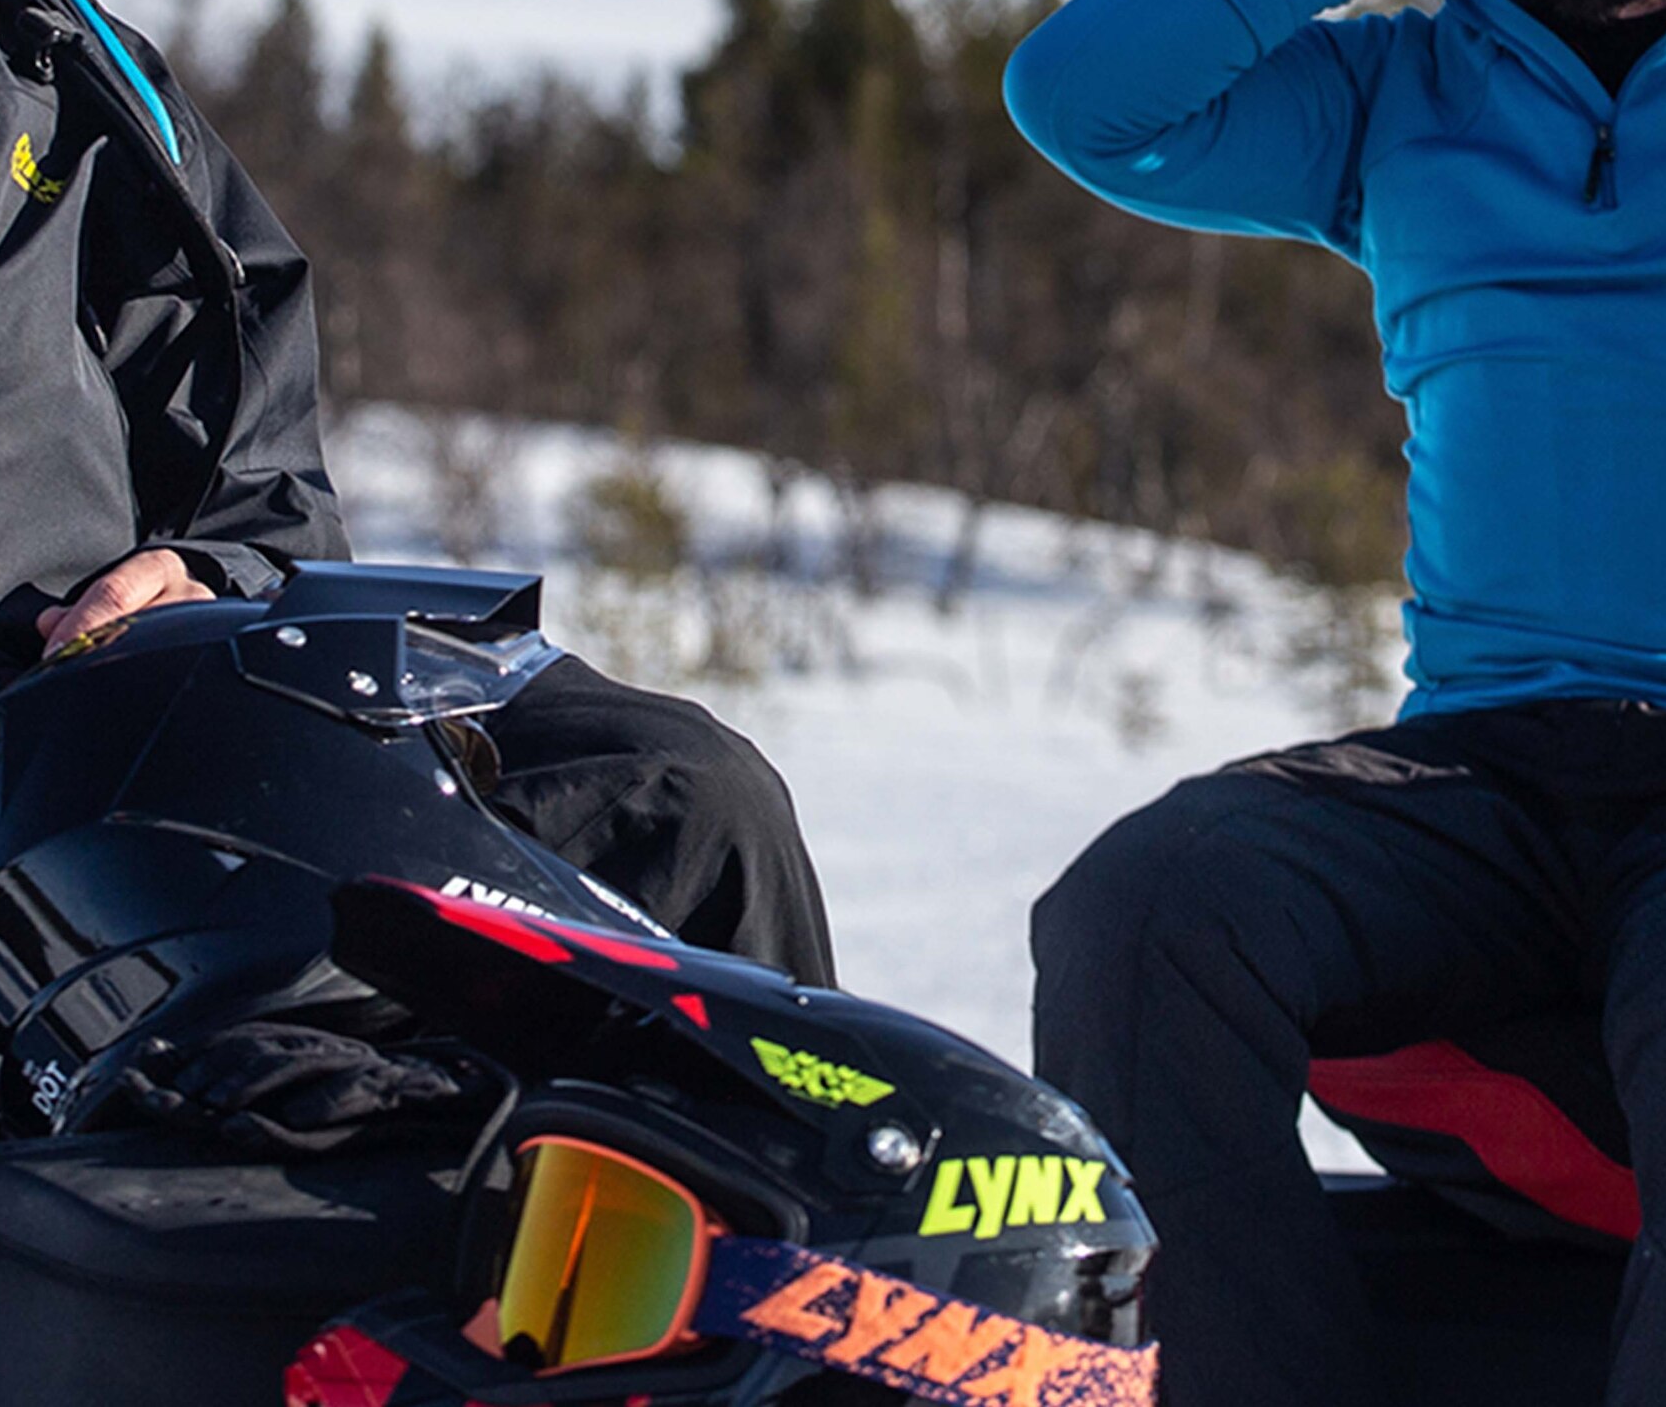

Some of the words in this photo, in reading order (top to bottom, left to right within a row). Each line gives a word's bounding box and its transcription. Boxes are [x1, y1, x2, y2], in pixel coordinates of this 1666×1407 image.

[32, 1060, 68, 1116] DOT
[918, 1155, 1107, 1240] LYNX
[740, 1261, 1085, 1406] LYNX
